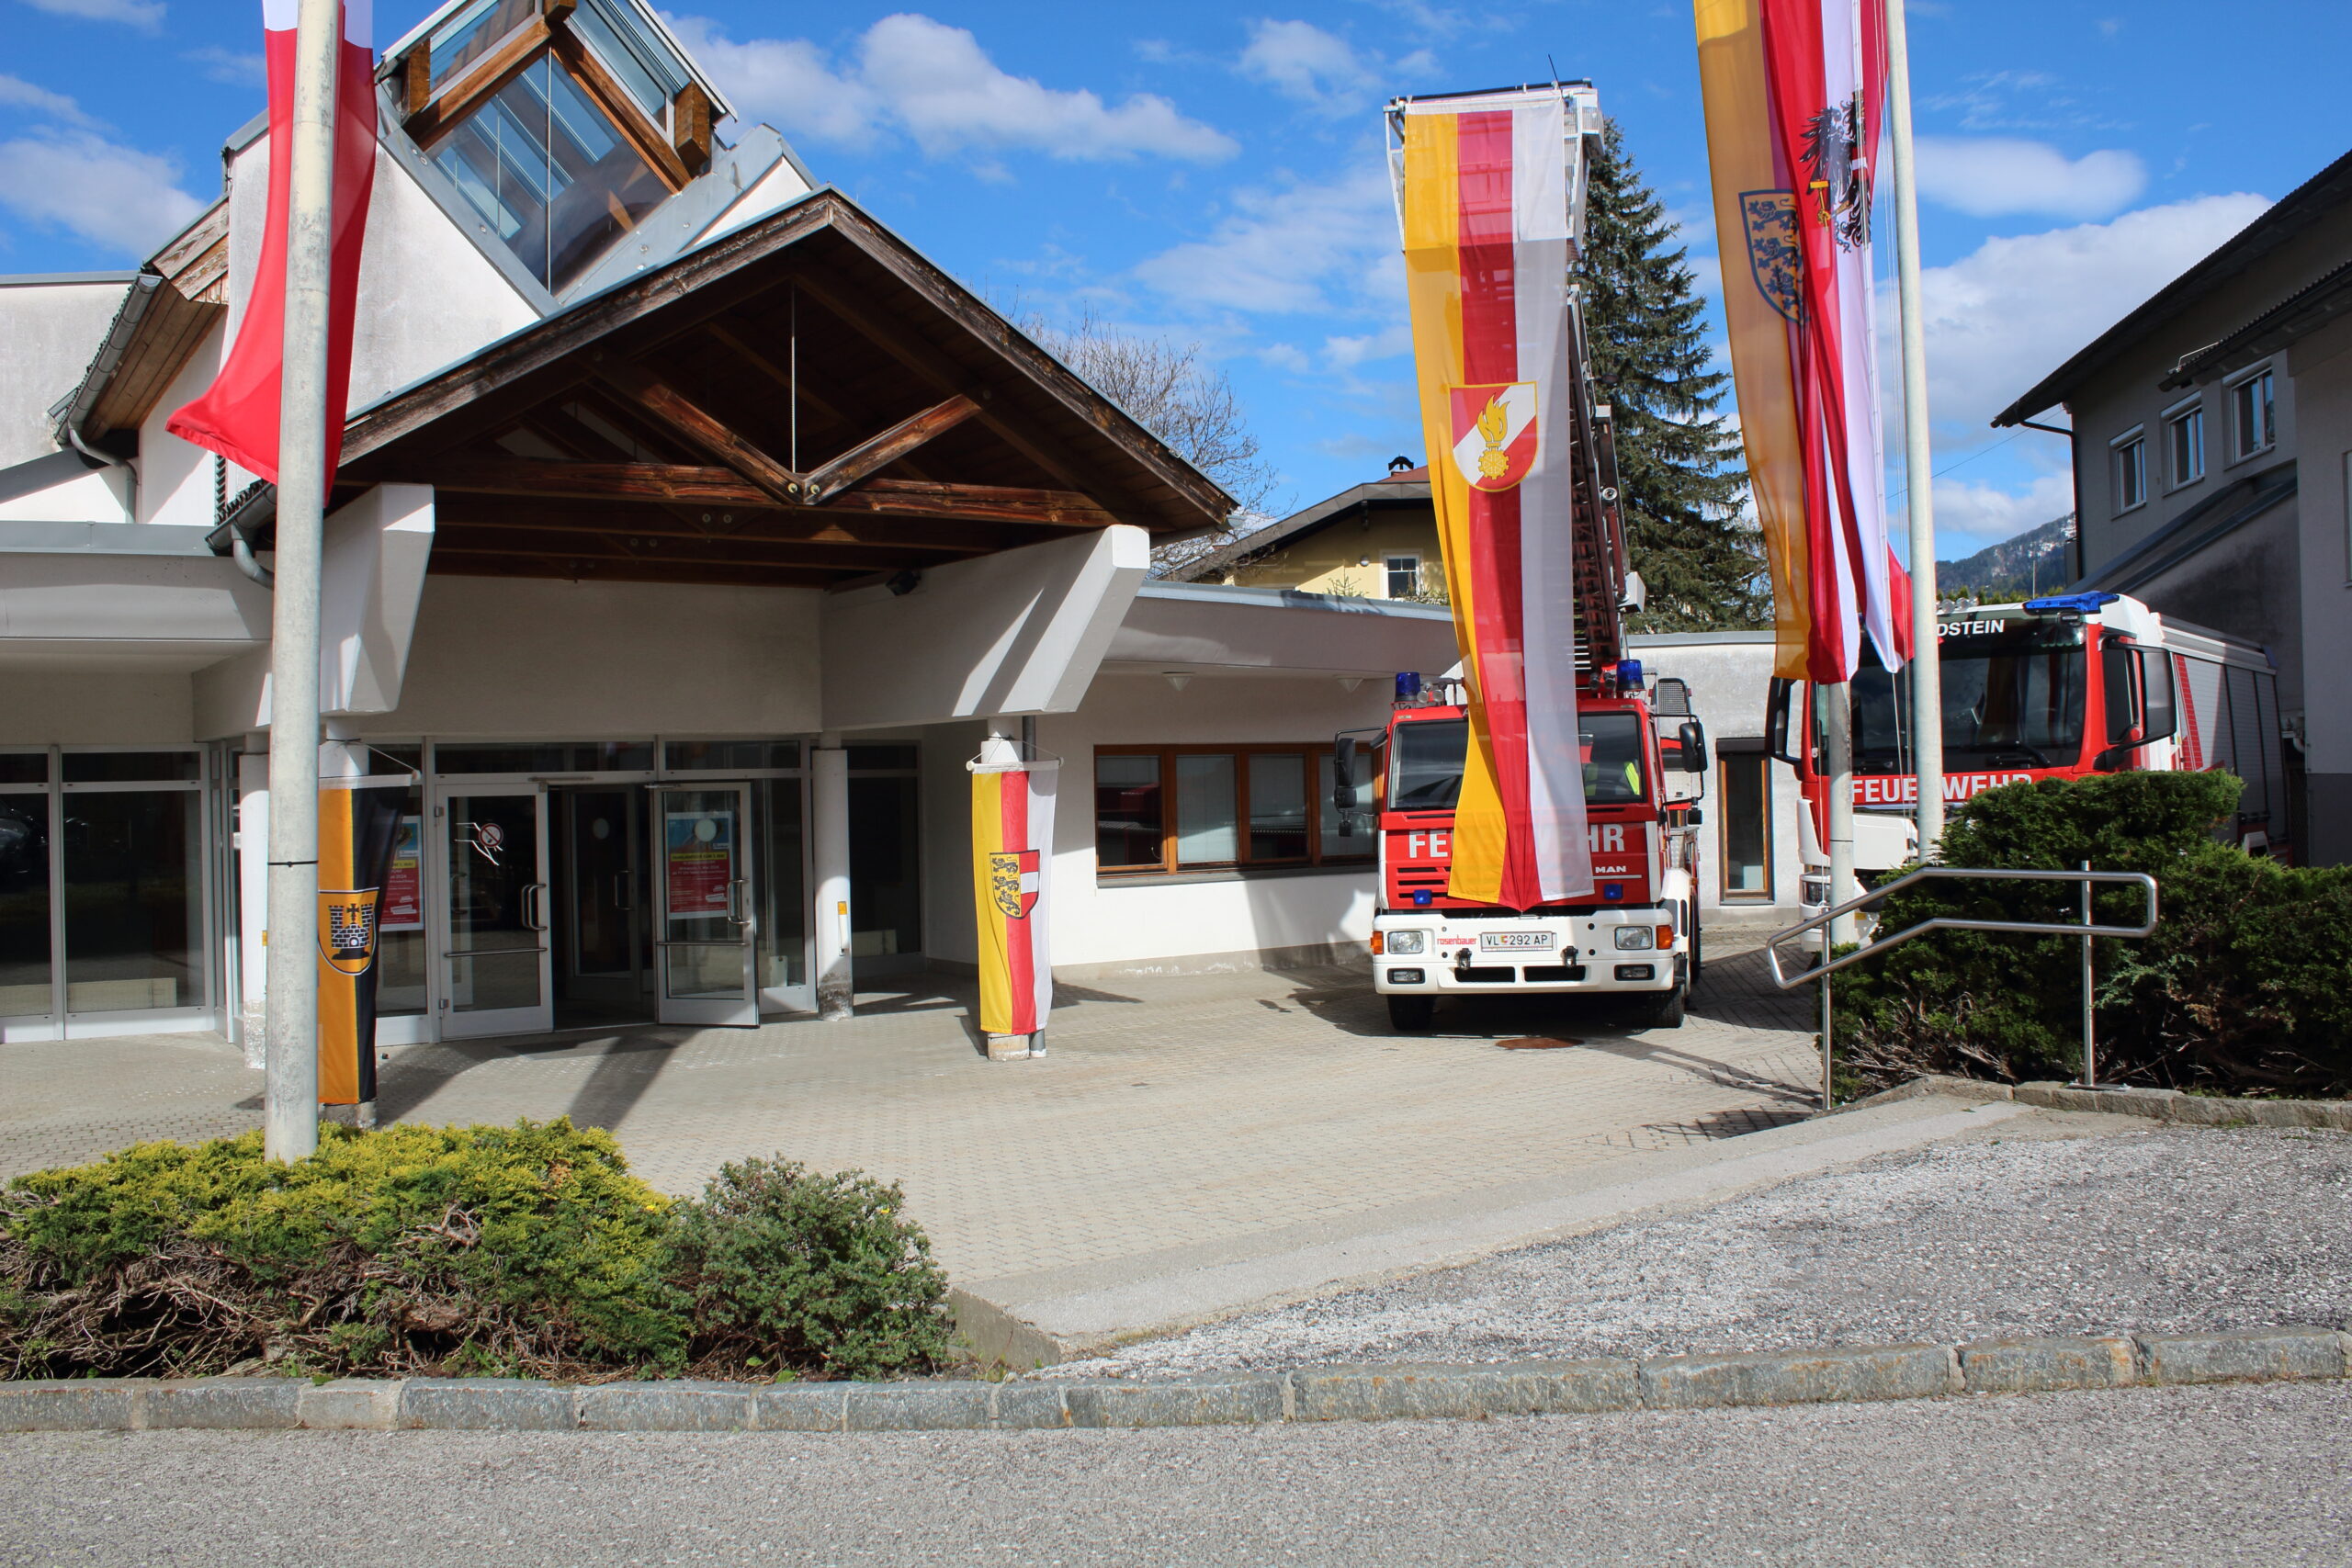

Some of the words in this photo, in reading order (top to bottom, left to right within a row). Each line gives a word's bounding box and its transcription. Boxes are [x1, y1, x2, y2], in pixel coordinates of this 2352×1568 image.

[1937, 619, 2005, 637] DSTEIN
[1595, 865, 1626, 874] MAN
[1437, 934, 1476, 944] rosenbauer
[1486, 935, 1498, 945] VL
[1510, 934, 1531, 945] 292
[1533, 935, 1548, 944] AP
